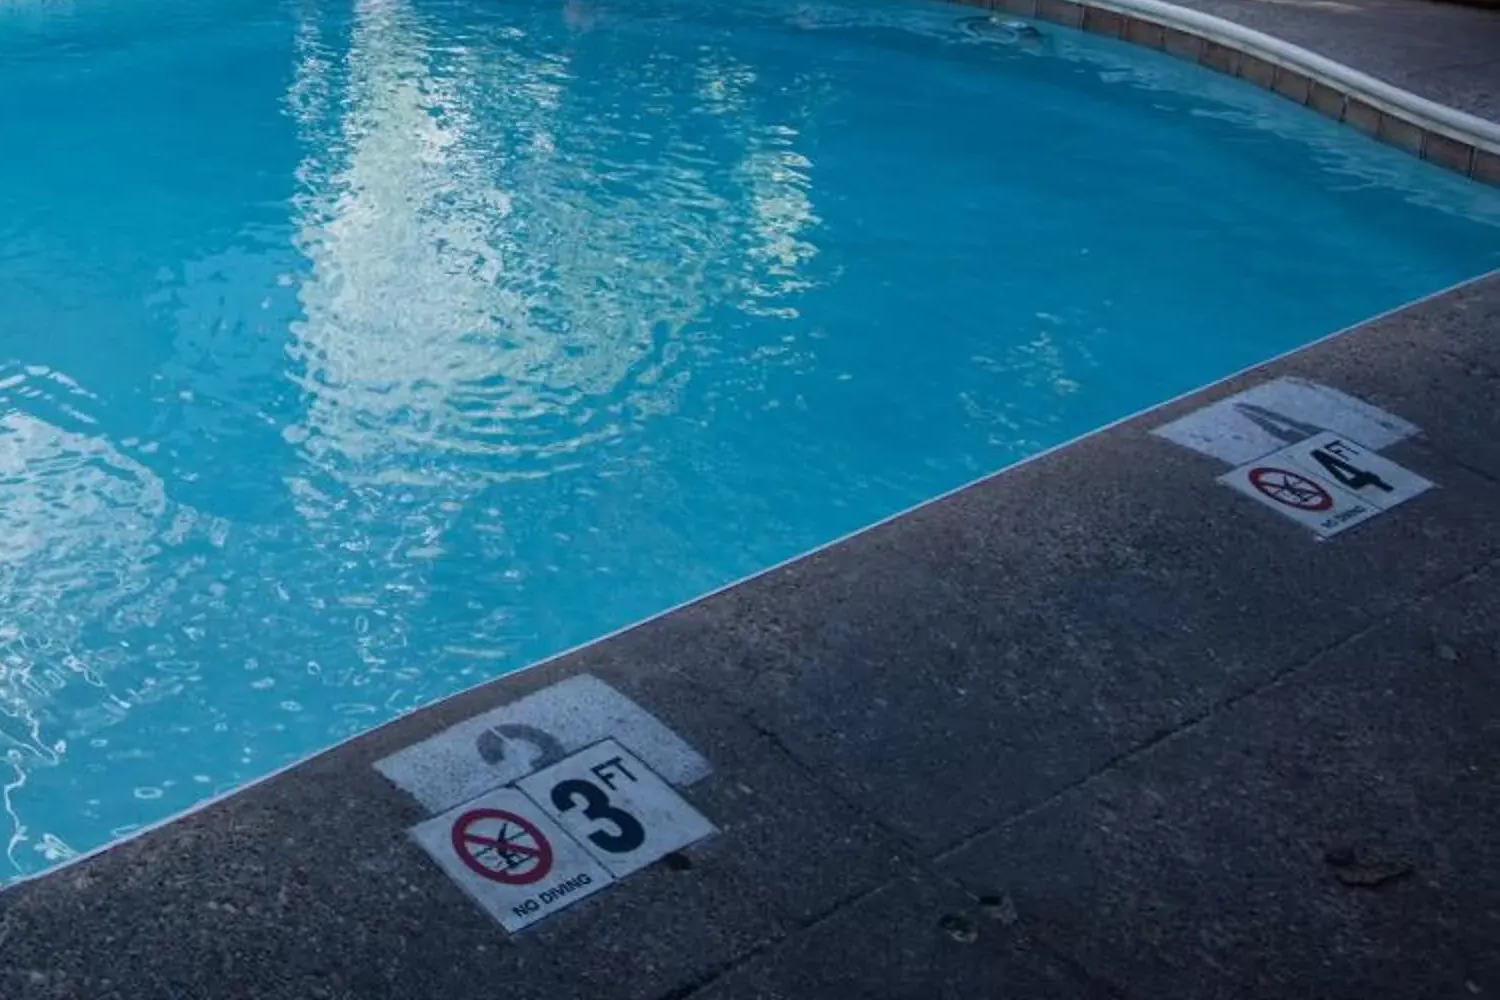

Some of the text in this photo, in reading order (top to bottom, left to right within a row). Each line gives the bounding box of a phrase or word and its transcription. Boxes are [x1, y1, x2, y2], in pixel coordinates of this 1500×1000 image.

[1310, 448, 1395, 494] 4
[1323, 440, 1360, 461] FT
[590, 755, 638, 791] FT
[550, 778, 646, 853] 3
[512, 872, 593, 917] NO DIVING
